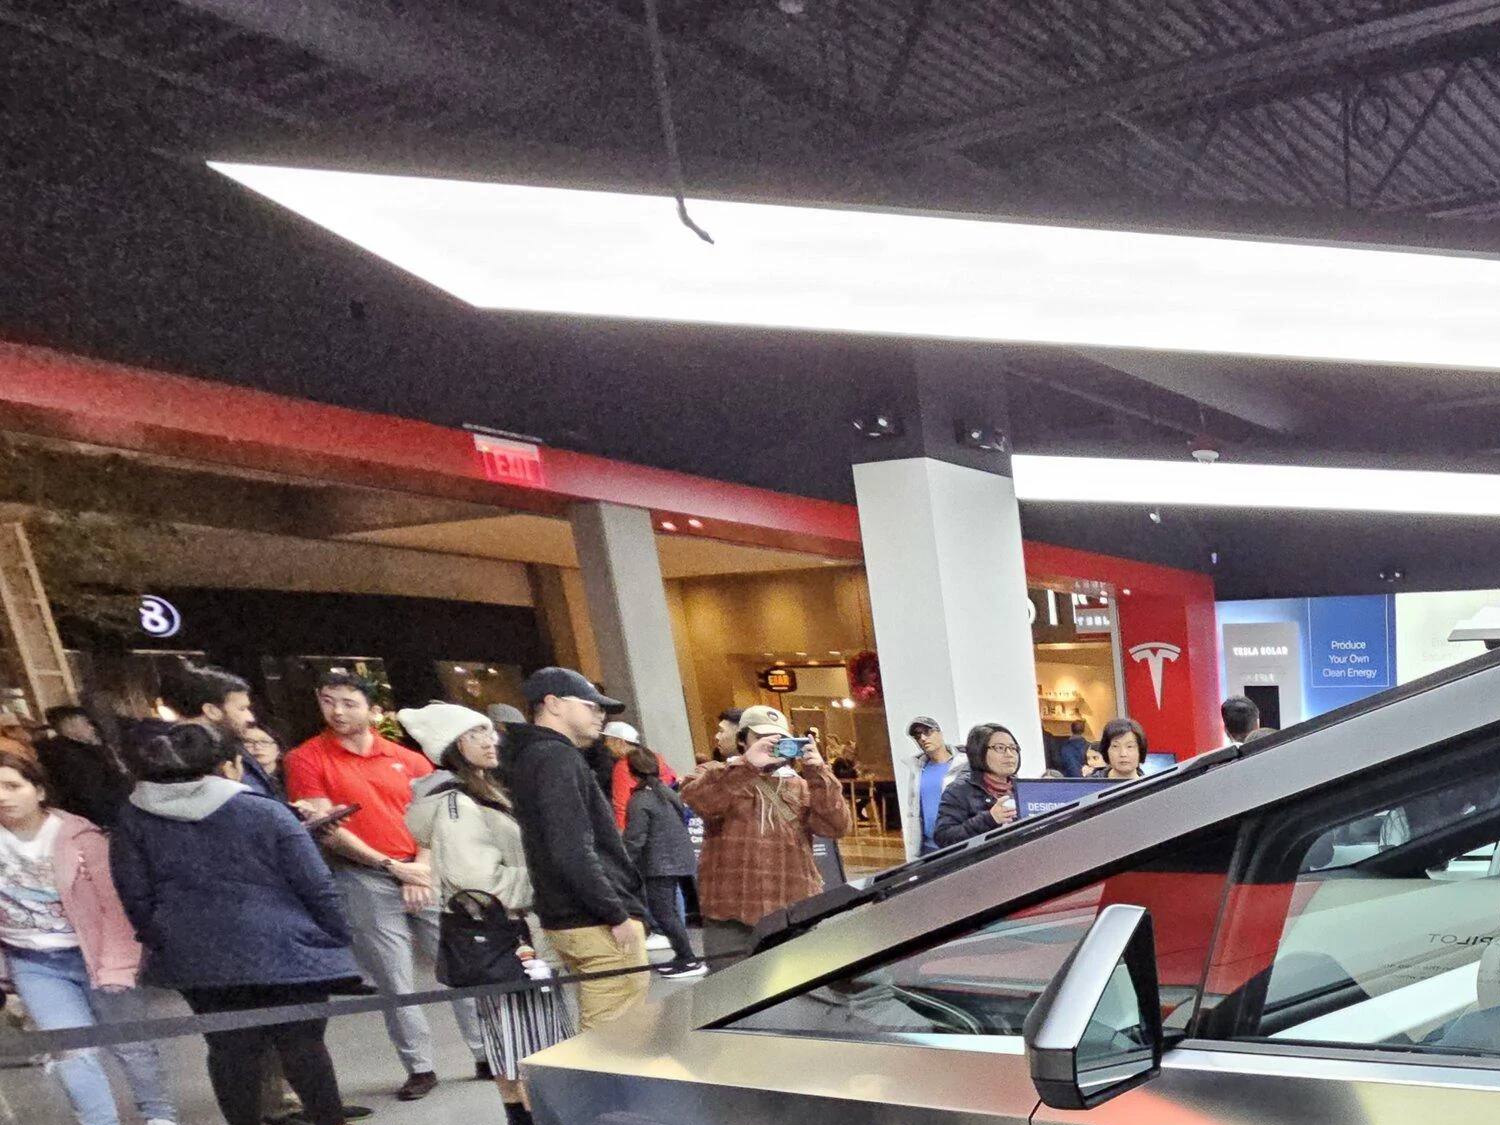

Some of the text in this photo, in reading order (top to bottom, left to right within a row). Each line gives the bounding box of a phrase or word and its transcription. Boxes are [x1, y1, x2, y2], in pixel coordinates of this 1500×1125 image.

[494, 451, 534, 481] EXIT
[1331, 640, 1366, 650] Produce
[1329, 654, 1370, 664] Your Own
[1322, 667, 1378, 679] Clean Energy
[1028, 802, 1067, 812] DESIGN
